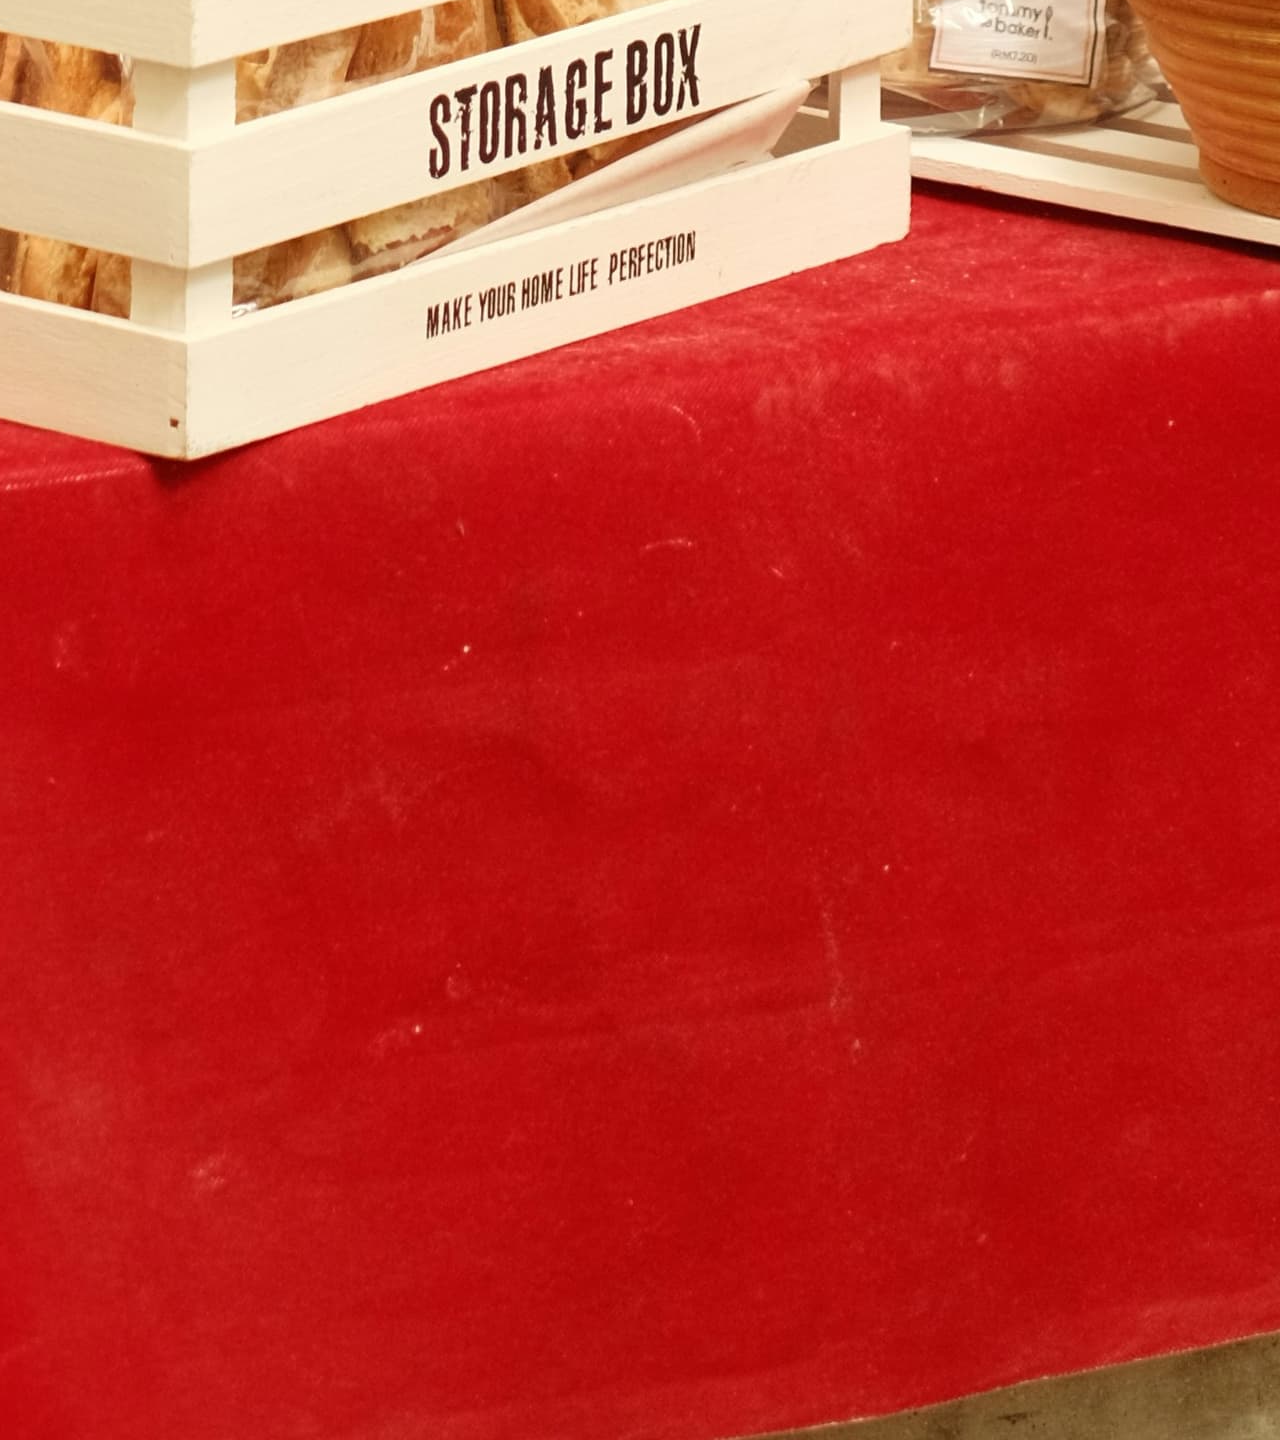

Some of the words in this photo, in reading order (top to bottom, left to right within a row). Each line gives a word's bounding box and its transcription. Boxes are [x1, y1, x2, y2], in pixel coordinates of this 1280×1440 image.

[995, 17, 1041, 39] baker
[429, 48, 614, 179] STORAGE
[626, 24, 702, 125] BOX
[426, 291, 472, 339] MAKE
[478, 281, 516, 323] YOUR
[521, 268, 563, 310] HOME
[569, 257, 598, 298] LIFE
[609, 230, 696, 286] PERFECTION
